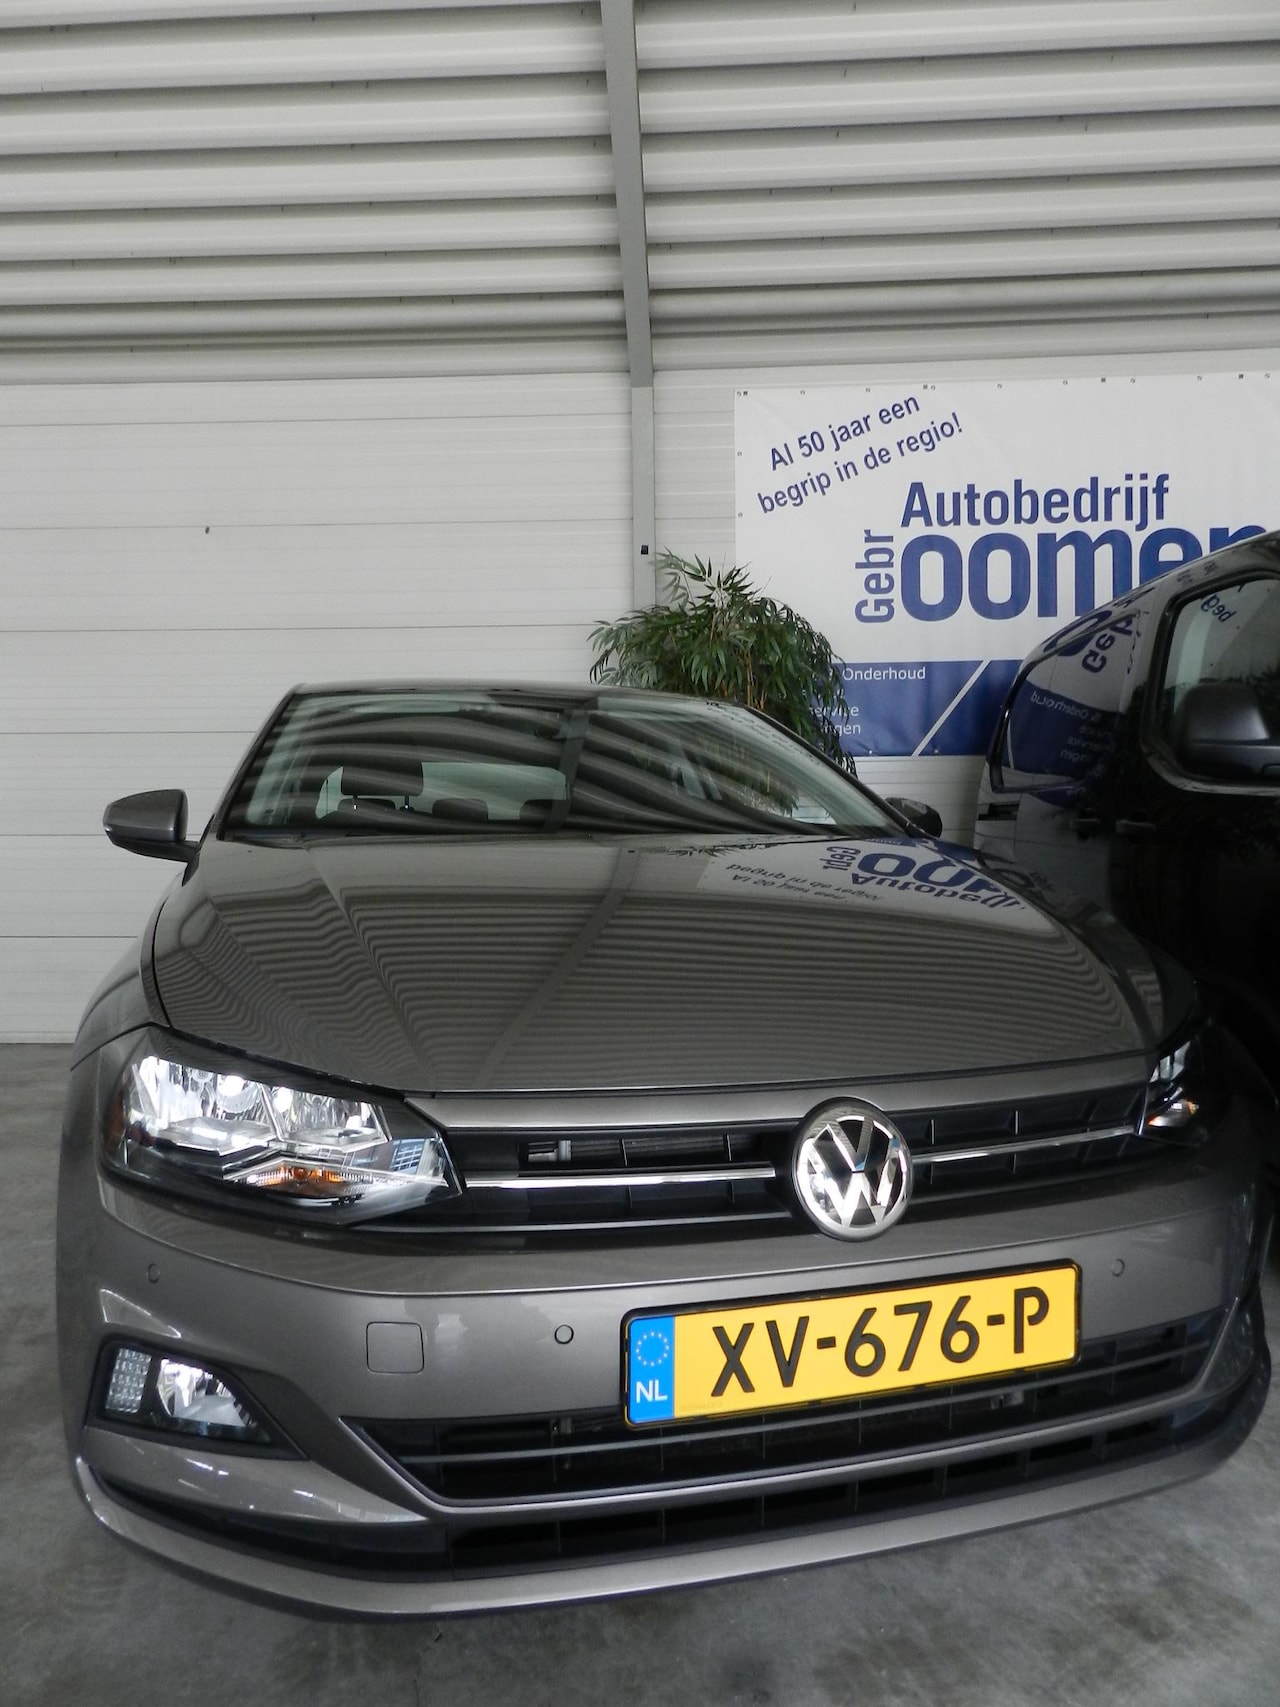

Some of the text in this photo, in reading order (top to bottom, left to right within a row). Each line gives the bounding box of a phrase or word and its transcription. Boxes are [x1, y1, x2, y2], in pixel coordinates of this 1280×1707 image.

[757, 412, 963, 514] begrip in de regio!
[770, 396, 920, 471] Al 50 jaar een
[900, 473, 1170, 532] Autobedrijf
[854, 529, 895, 624] Gebr
[842, 666, 926, 681] Onderhoud
[711, 1286, 1050, 1398] XV-676-P
[636, 1379, 668, 1403] NL
